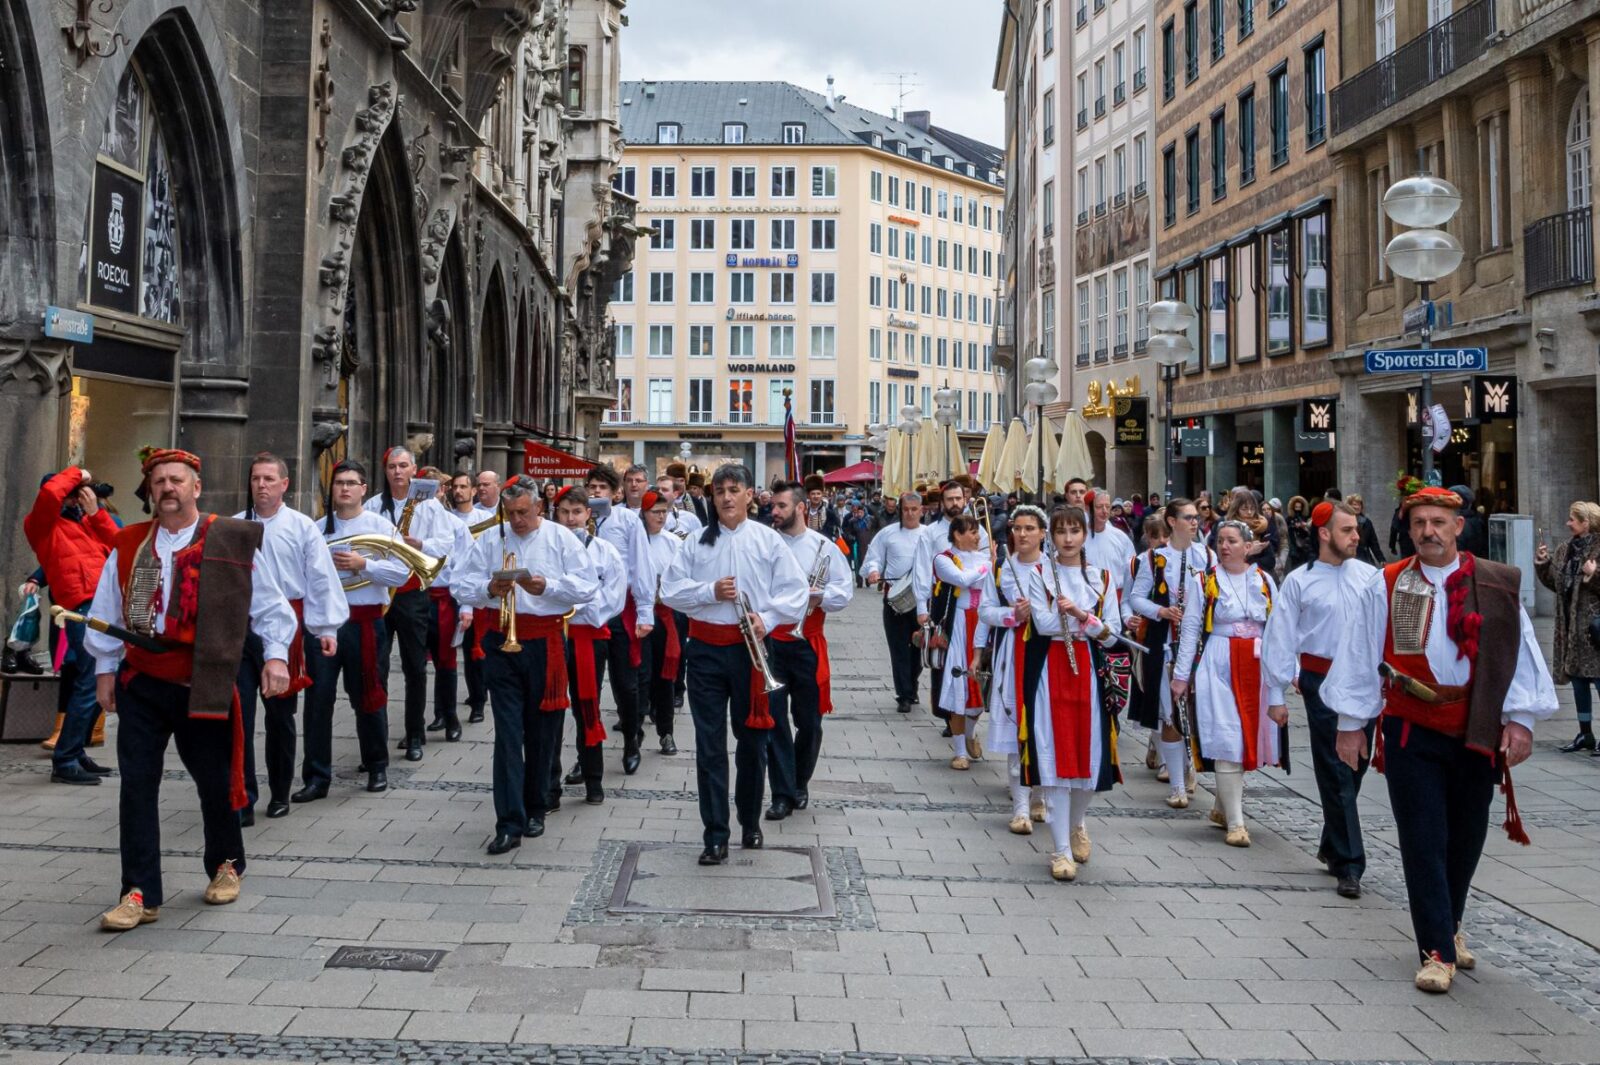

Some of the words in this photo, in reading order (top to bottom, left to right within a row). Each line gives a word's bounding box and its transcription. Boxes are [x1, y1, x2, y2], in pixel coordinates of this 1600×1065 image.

[97, 261, 130, 287] ROECKL
[727, 363, 796, 373] WORMLAND
[1374, 350, 1475, 370] Sporerstraße
[1483, 381, 1510, 413] WMF
[1310, 403, 1330, 428] WMF
[1184, 438, 1207, 447] COS
[528, 455, 561, 464] Imbiss
